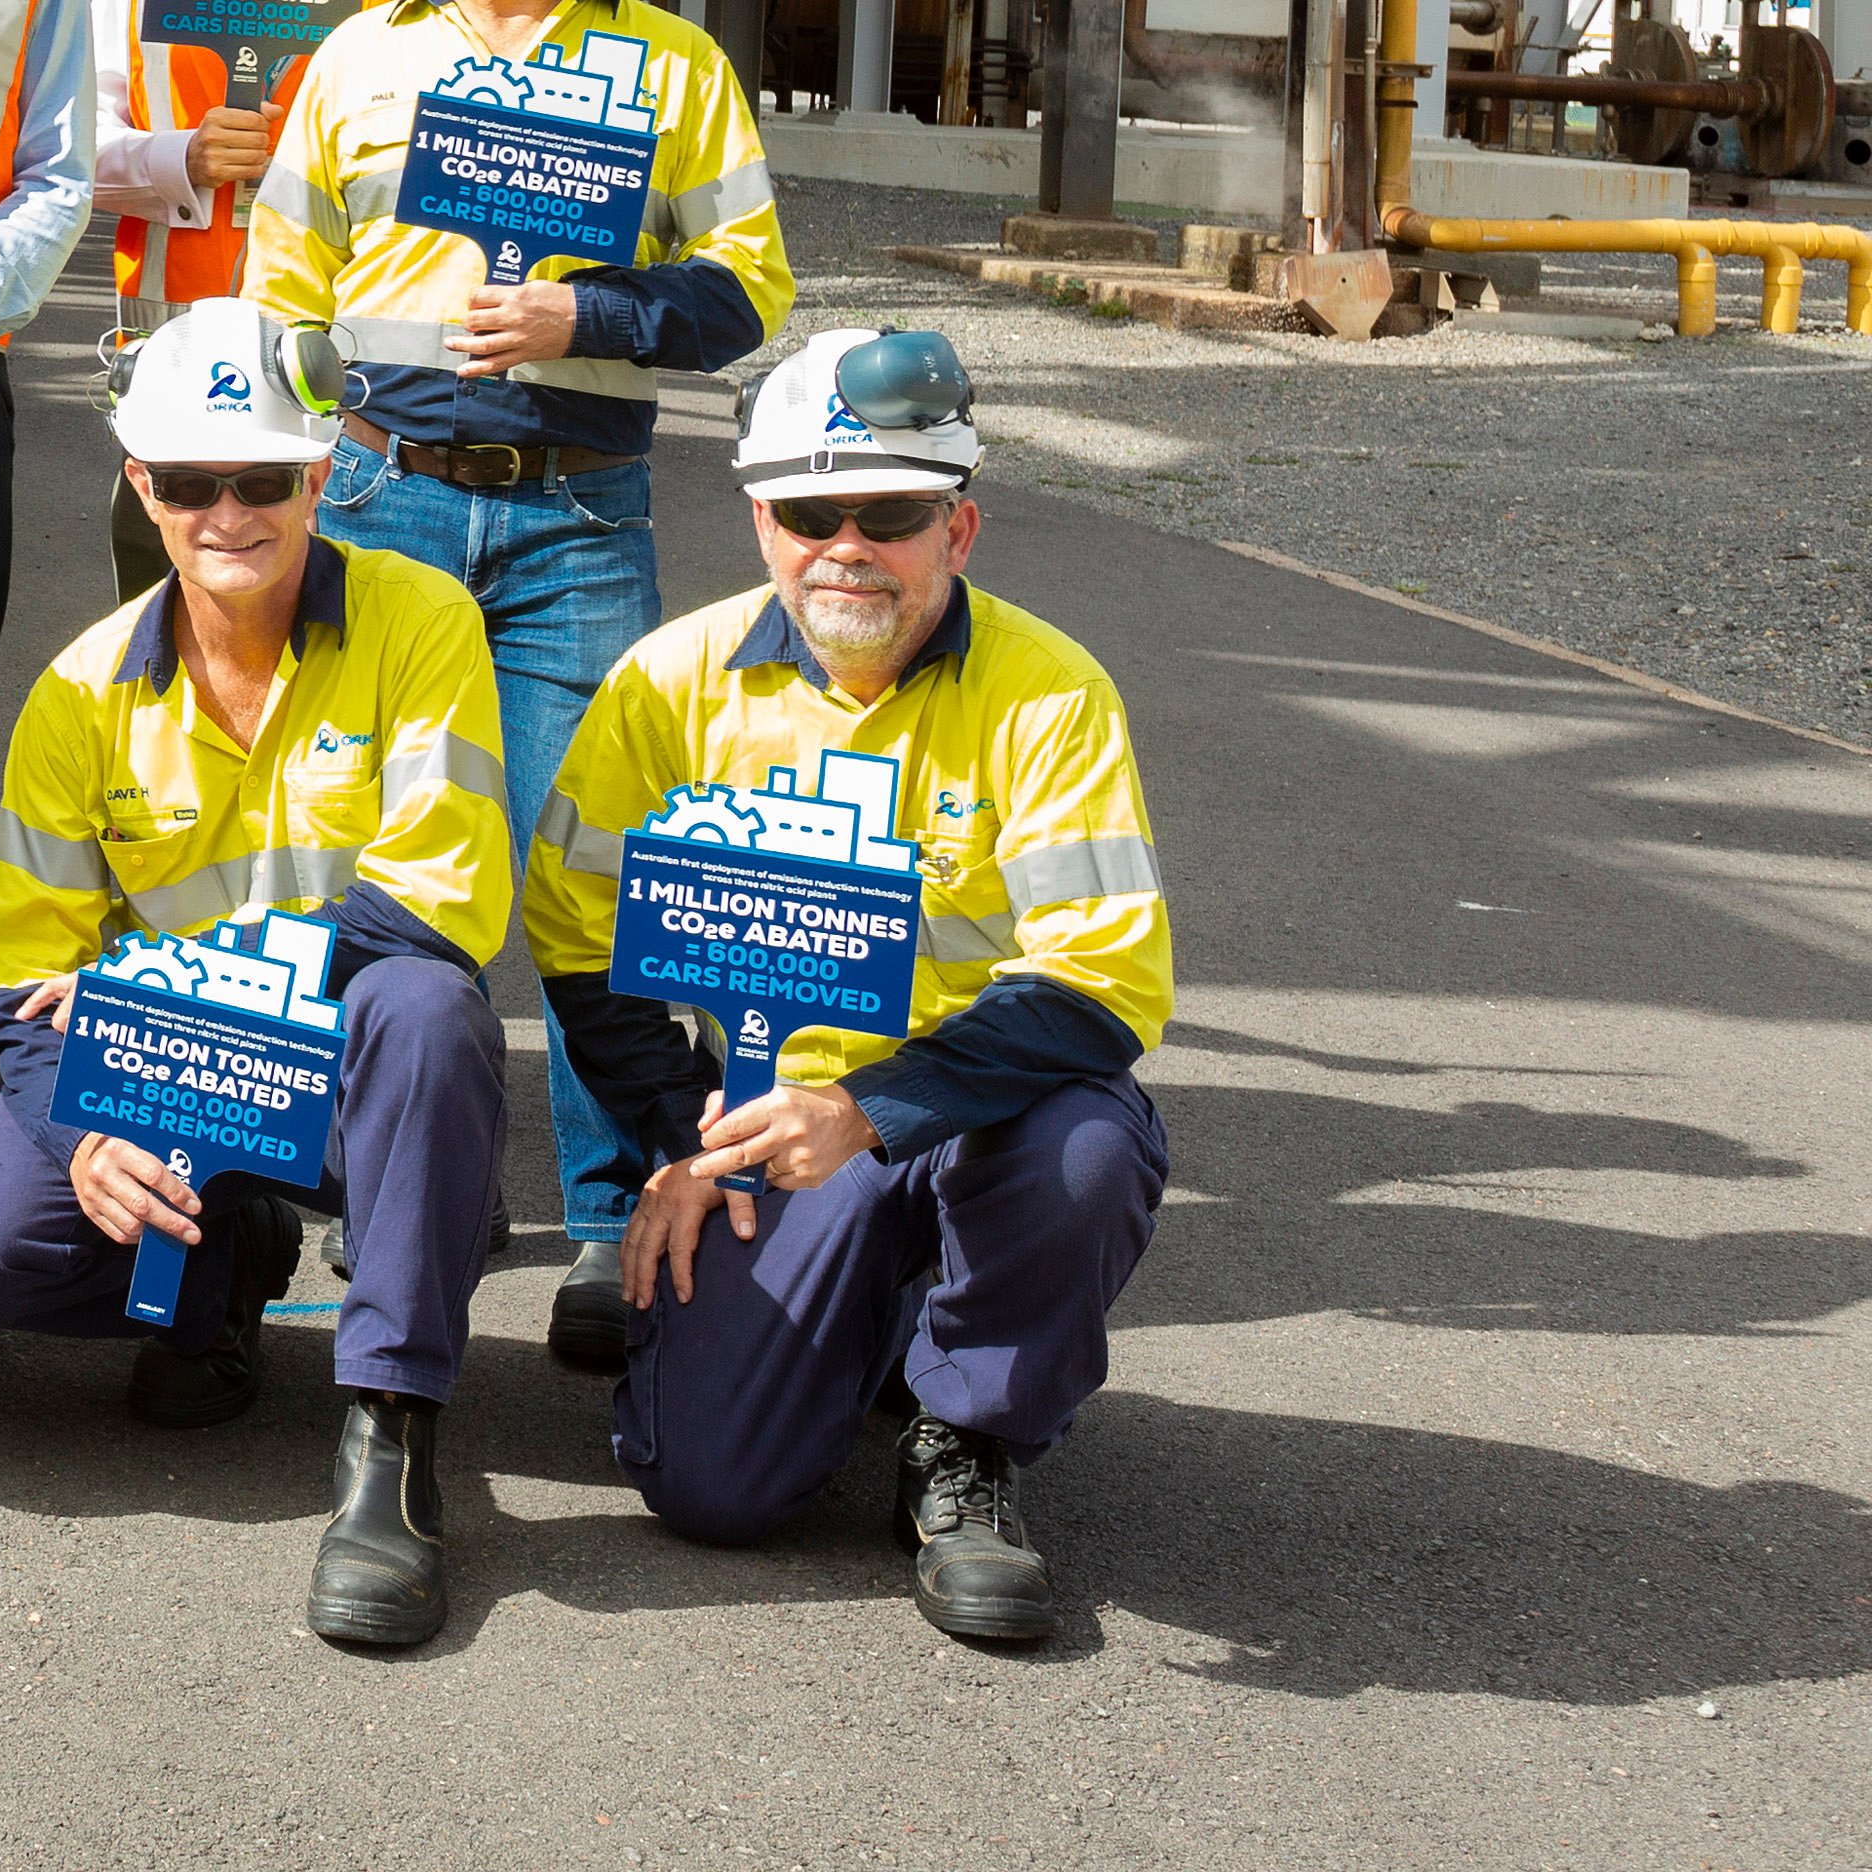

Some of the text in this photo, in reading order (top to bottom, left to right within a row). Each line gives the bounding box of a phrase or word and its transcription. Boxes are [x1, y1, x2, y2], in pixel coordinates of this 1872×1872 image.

[140, 787, 150, 798] H
[630, 850, 680, 866] Australian
[680, 857, 701, 869] first
[700, 861, 756, 878] deployment
[767, 873, 814, 887] emissions
[814, 880, 860, 893] reduction
[860, 886, 914, 903] technology
[701, 873, 838, 901] across three nitric acid plants
[628, 877, 908, 941] 1 MILLION TONNES
[707, 941, 840, 982] 600,000
[741, 921, 870, 960] ABATED
[639, 956, 882, 1014] CARS REMOVED
[75, 1015, 329, 1095] 1 MILLION TONNES
[141, 1081, 263, 1129] 600,000
[175, 1065, 292, 1110] ABATED
[78, 1090, 298, 1162] CARS REMOVED
